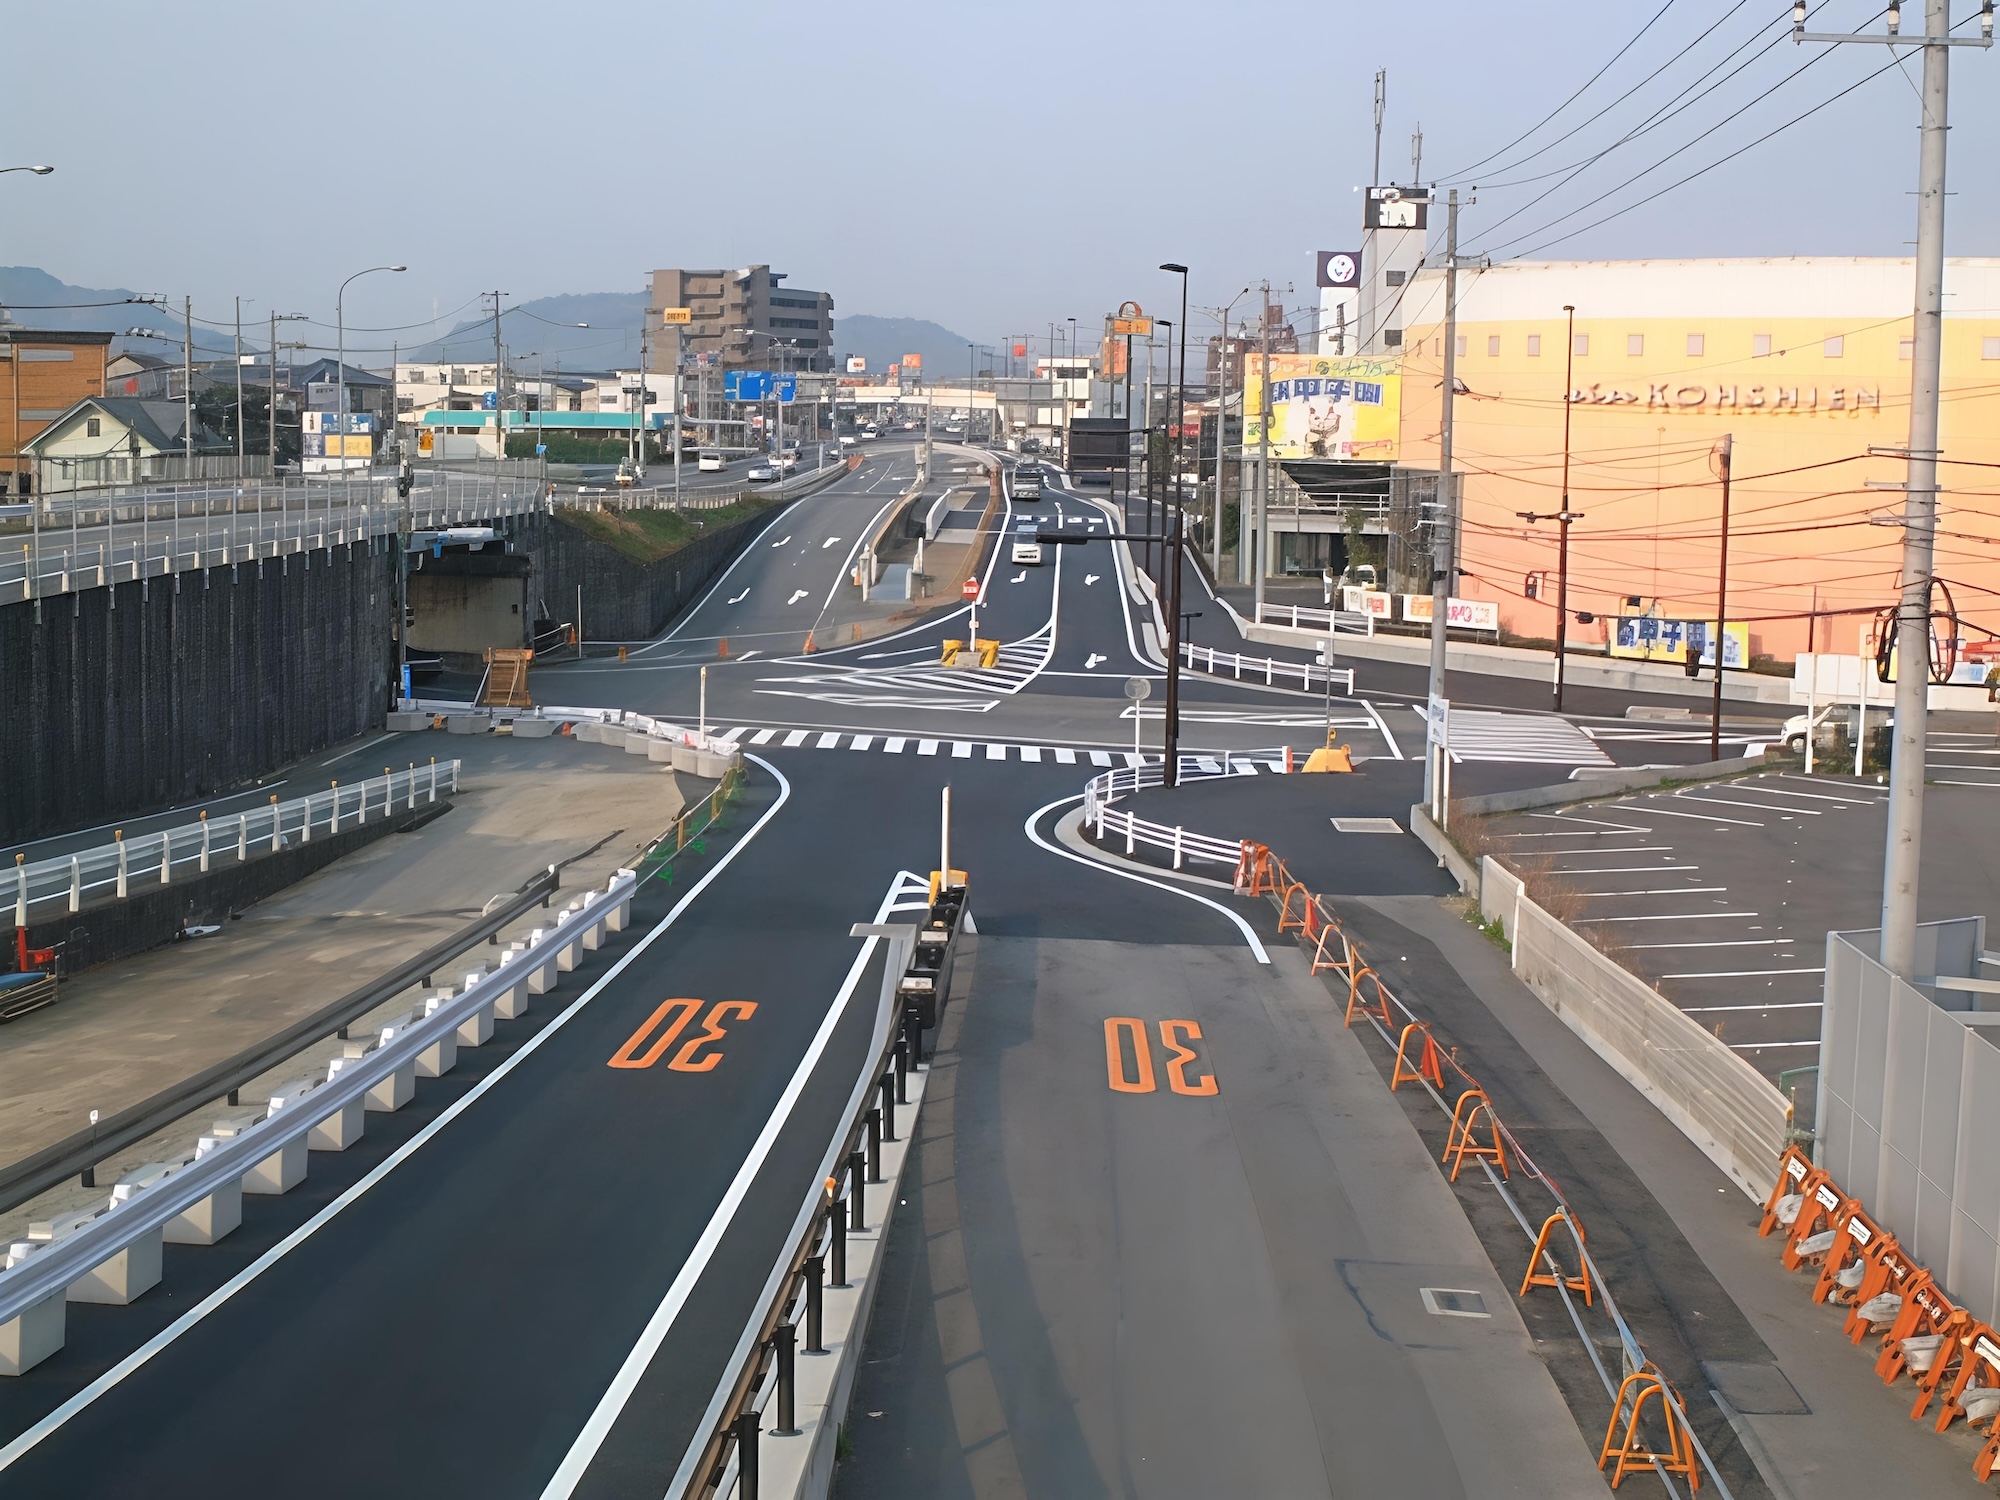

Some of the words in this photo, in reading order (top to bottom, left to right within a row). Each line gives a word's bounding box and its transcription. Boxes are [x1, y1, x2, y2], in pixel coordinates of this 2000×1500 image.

[1649, 383, 1881, 411] KOHSHIEN
[607, 997, 758, 1072] 30
[1104, 1017, 1219, 1096] 30
